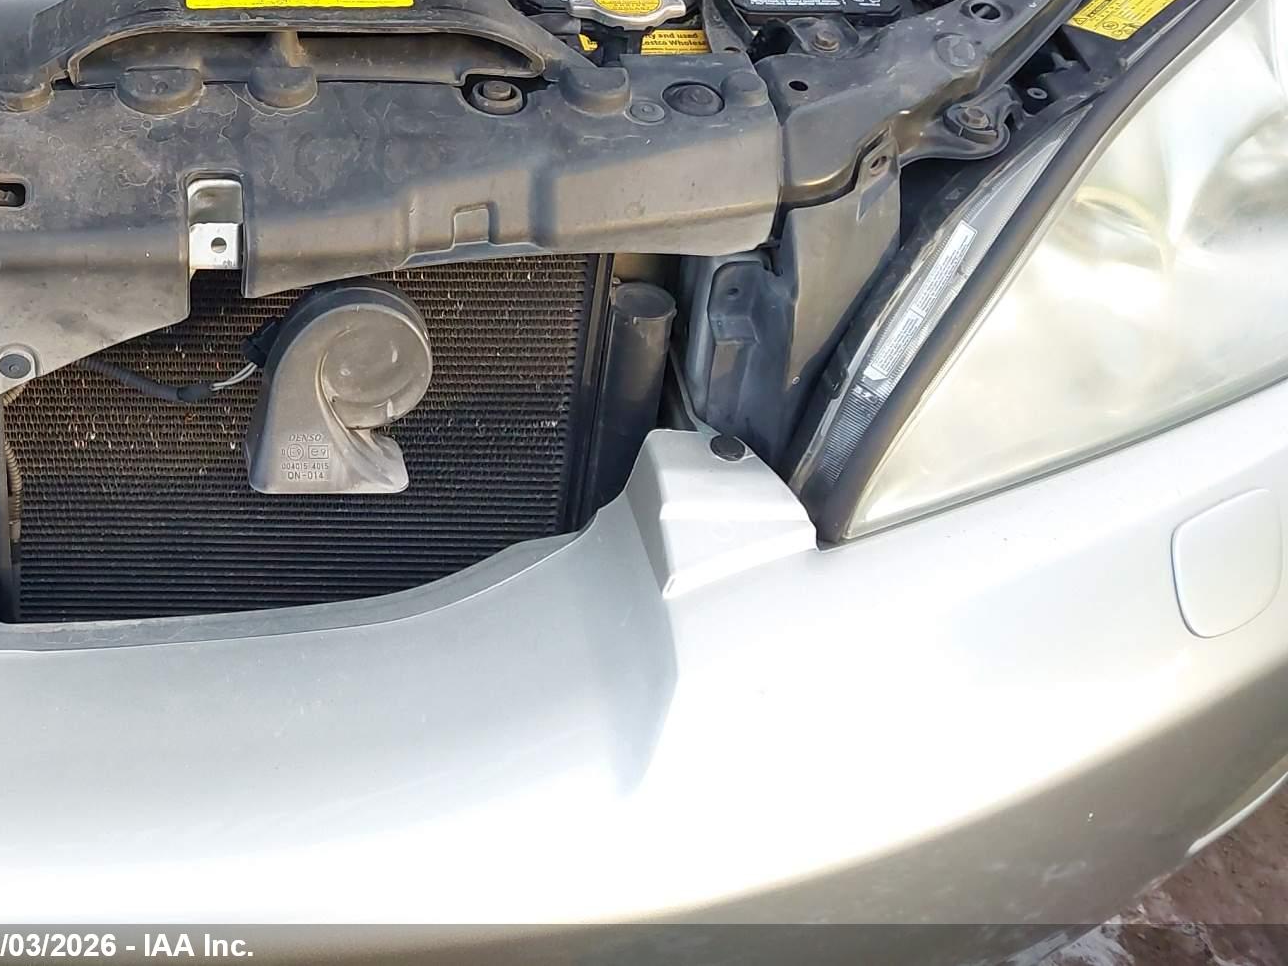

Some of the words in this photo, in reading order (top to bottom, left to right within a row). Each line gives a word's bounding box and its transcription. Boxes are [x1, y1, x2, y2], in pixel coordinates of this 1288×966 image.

[288, 434, 322, 442] DENSO
[311, 462, 329, 470] 4015
[287, 471, 323, 480] ON-014
